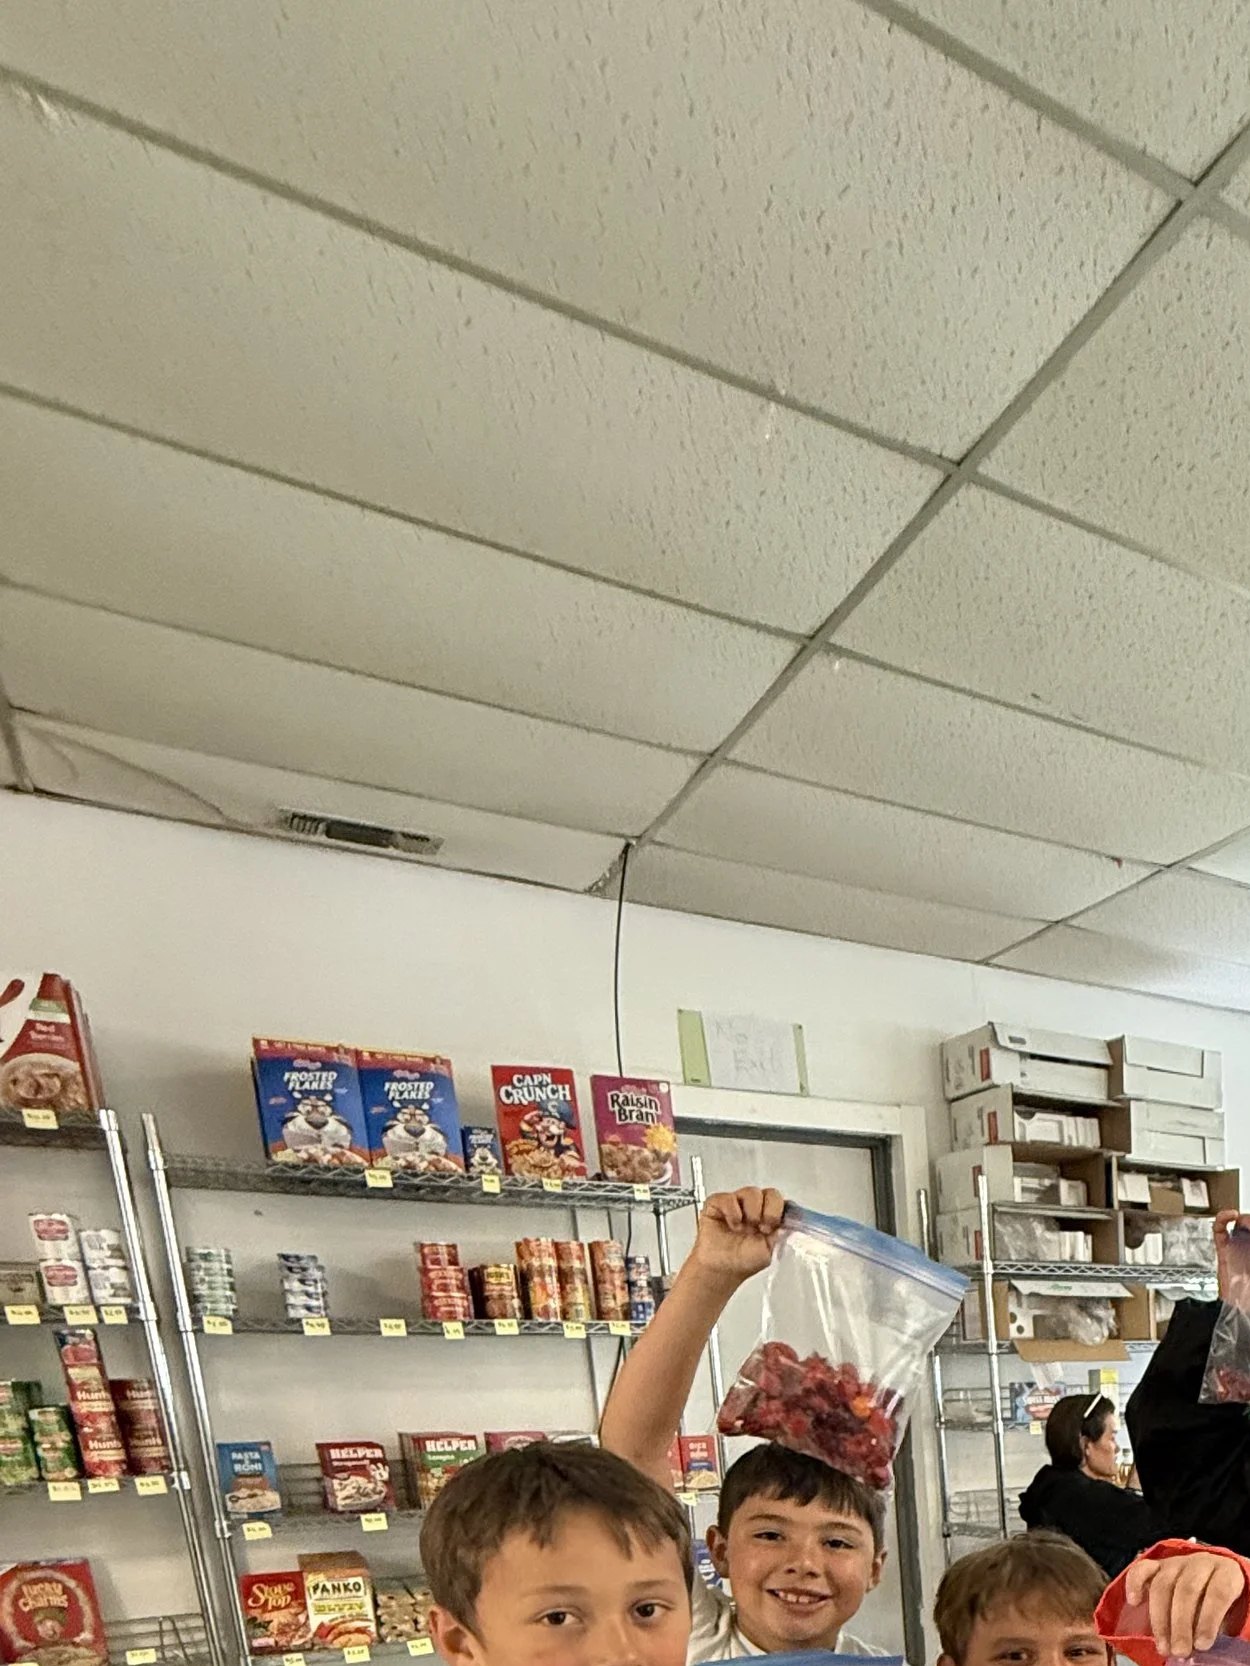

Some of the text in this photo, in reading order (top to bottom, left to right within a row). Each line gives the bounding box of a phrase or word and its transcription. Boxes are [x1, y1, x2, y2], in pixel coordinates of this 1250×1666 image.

[283, 1071, 338, 1082] FROSTED
[288, 1081, 333, 1091] FLAKES
[384, 1081, 435, 1092] FROSTED
[388, 1090, 431, 1101] FLAKES
[500, 1084, 570, 1105] CRUNCH
[608, 1091, 661, 1112] Raisin
[616, 1107, 657, 1125] Bran
[425, 1440, 477, 1452] HELPER
[231, 1451, 261, 1461] PASTA
[330, 1447, 383, 1459] HELPER
[233, 1463, 263, 1473] RONI
[312, 1581, 362, 1595] PANKO
